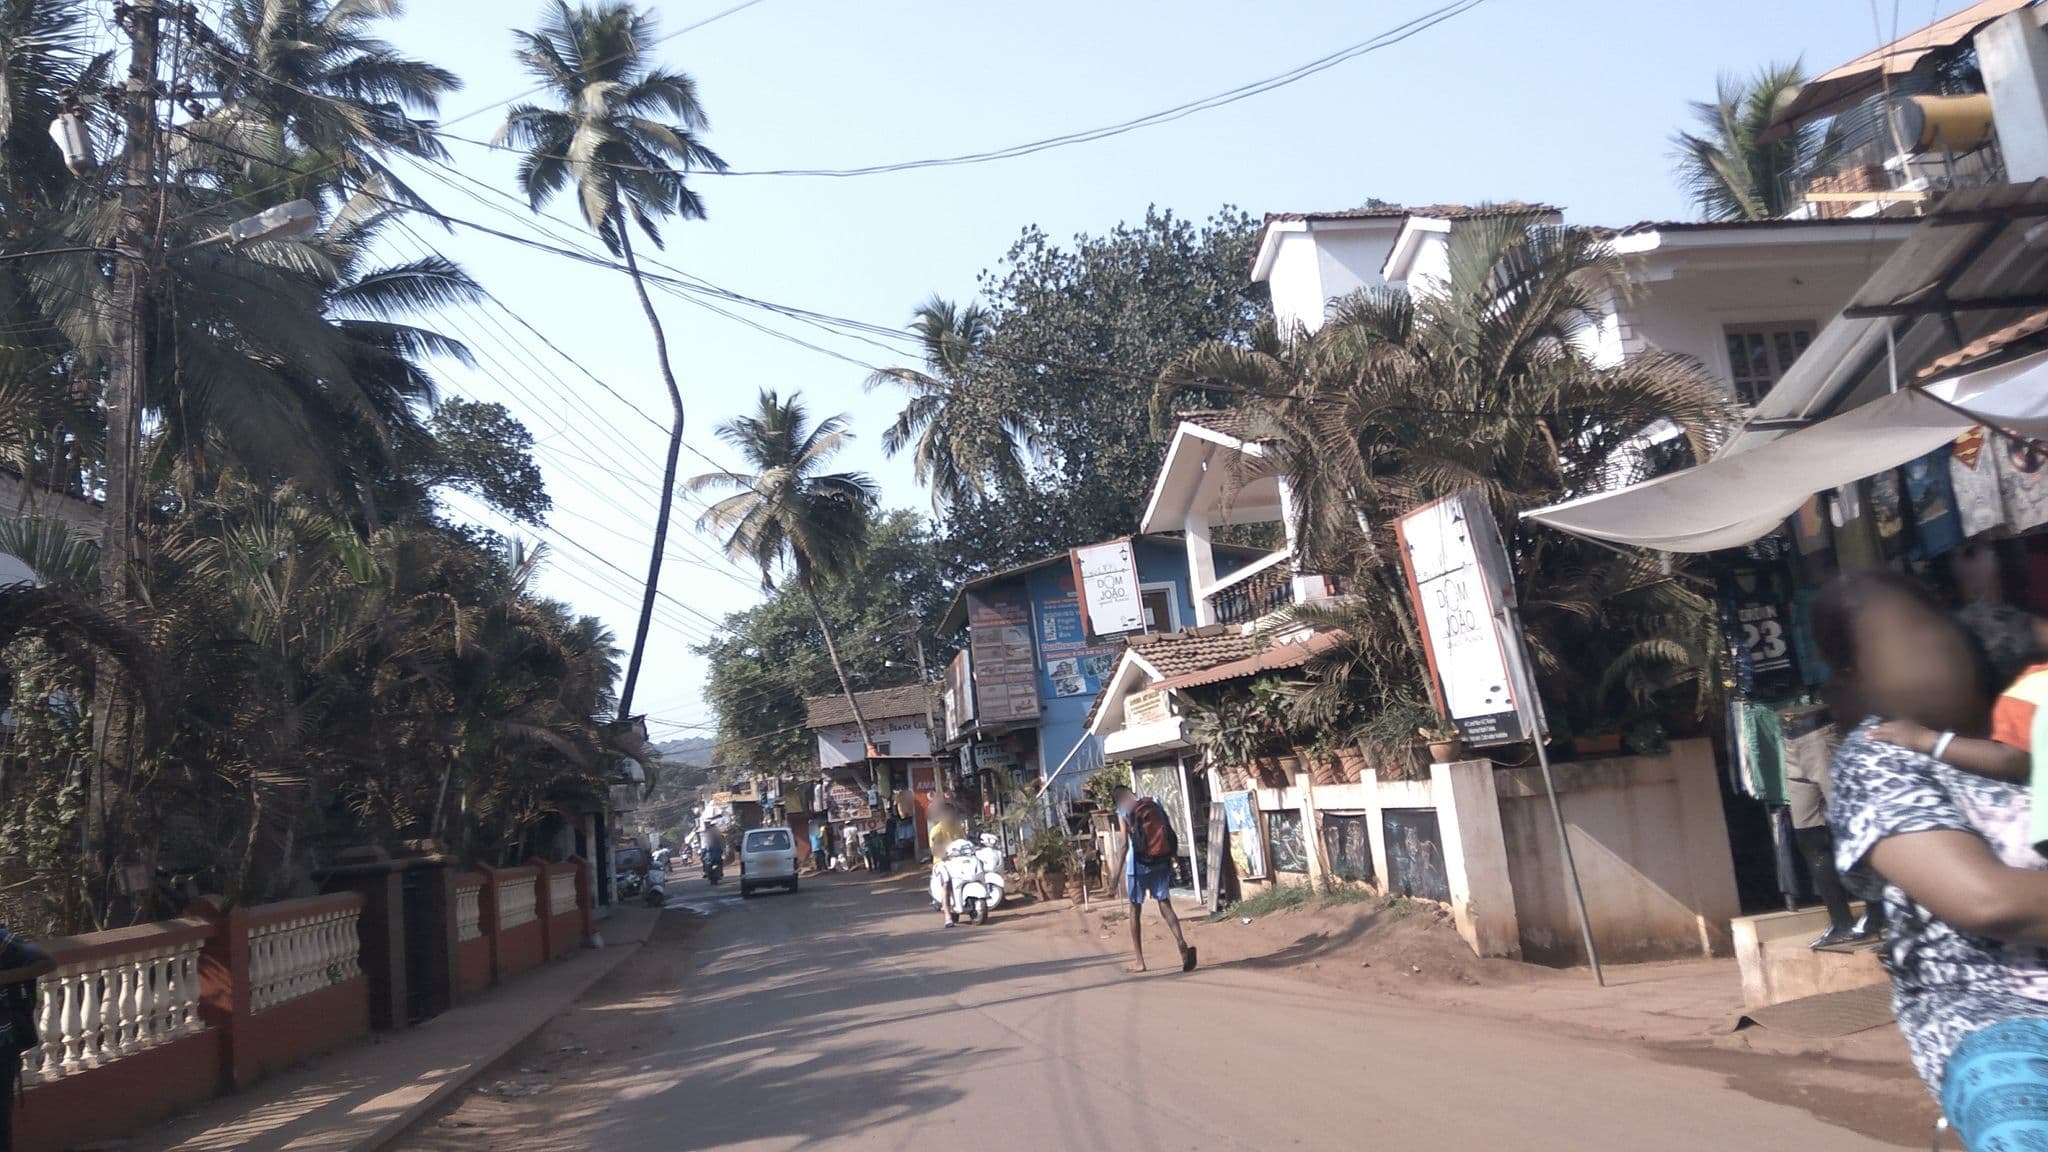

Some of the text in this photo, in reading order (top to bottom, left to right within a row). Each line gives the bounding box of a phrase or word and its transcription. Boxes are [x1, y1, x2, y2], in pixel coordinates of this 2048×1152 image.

[1097, 575, 1123, 589] DOM
[1436, 579, 1469, 611] DOM
[1743, 620, 1786, 660] 23
